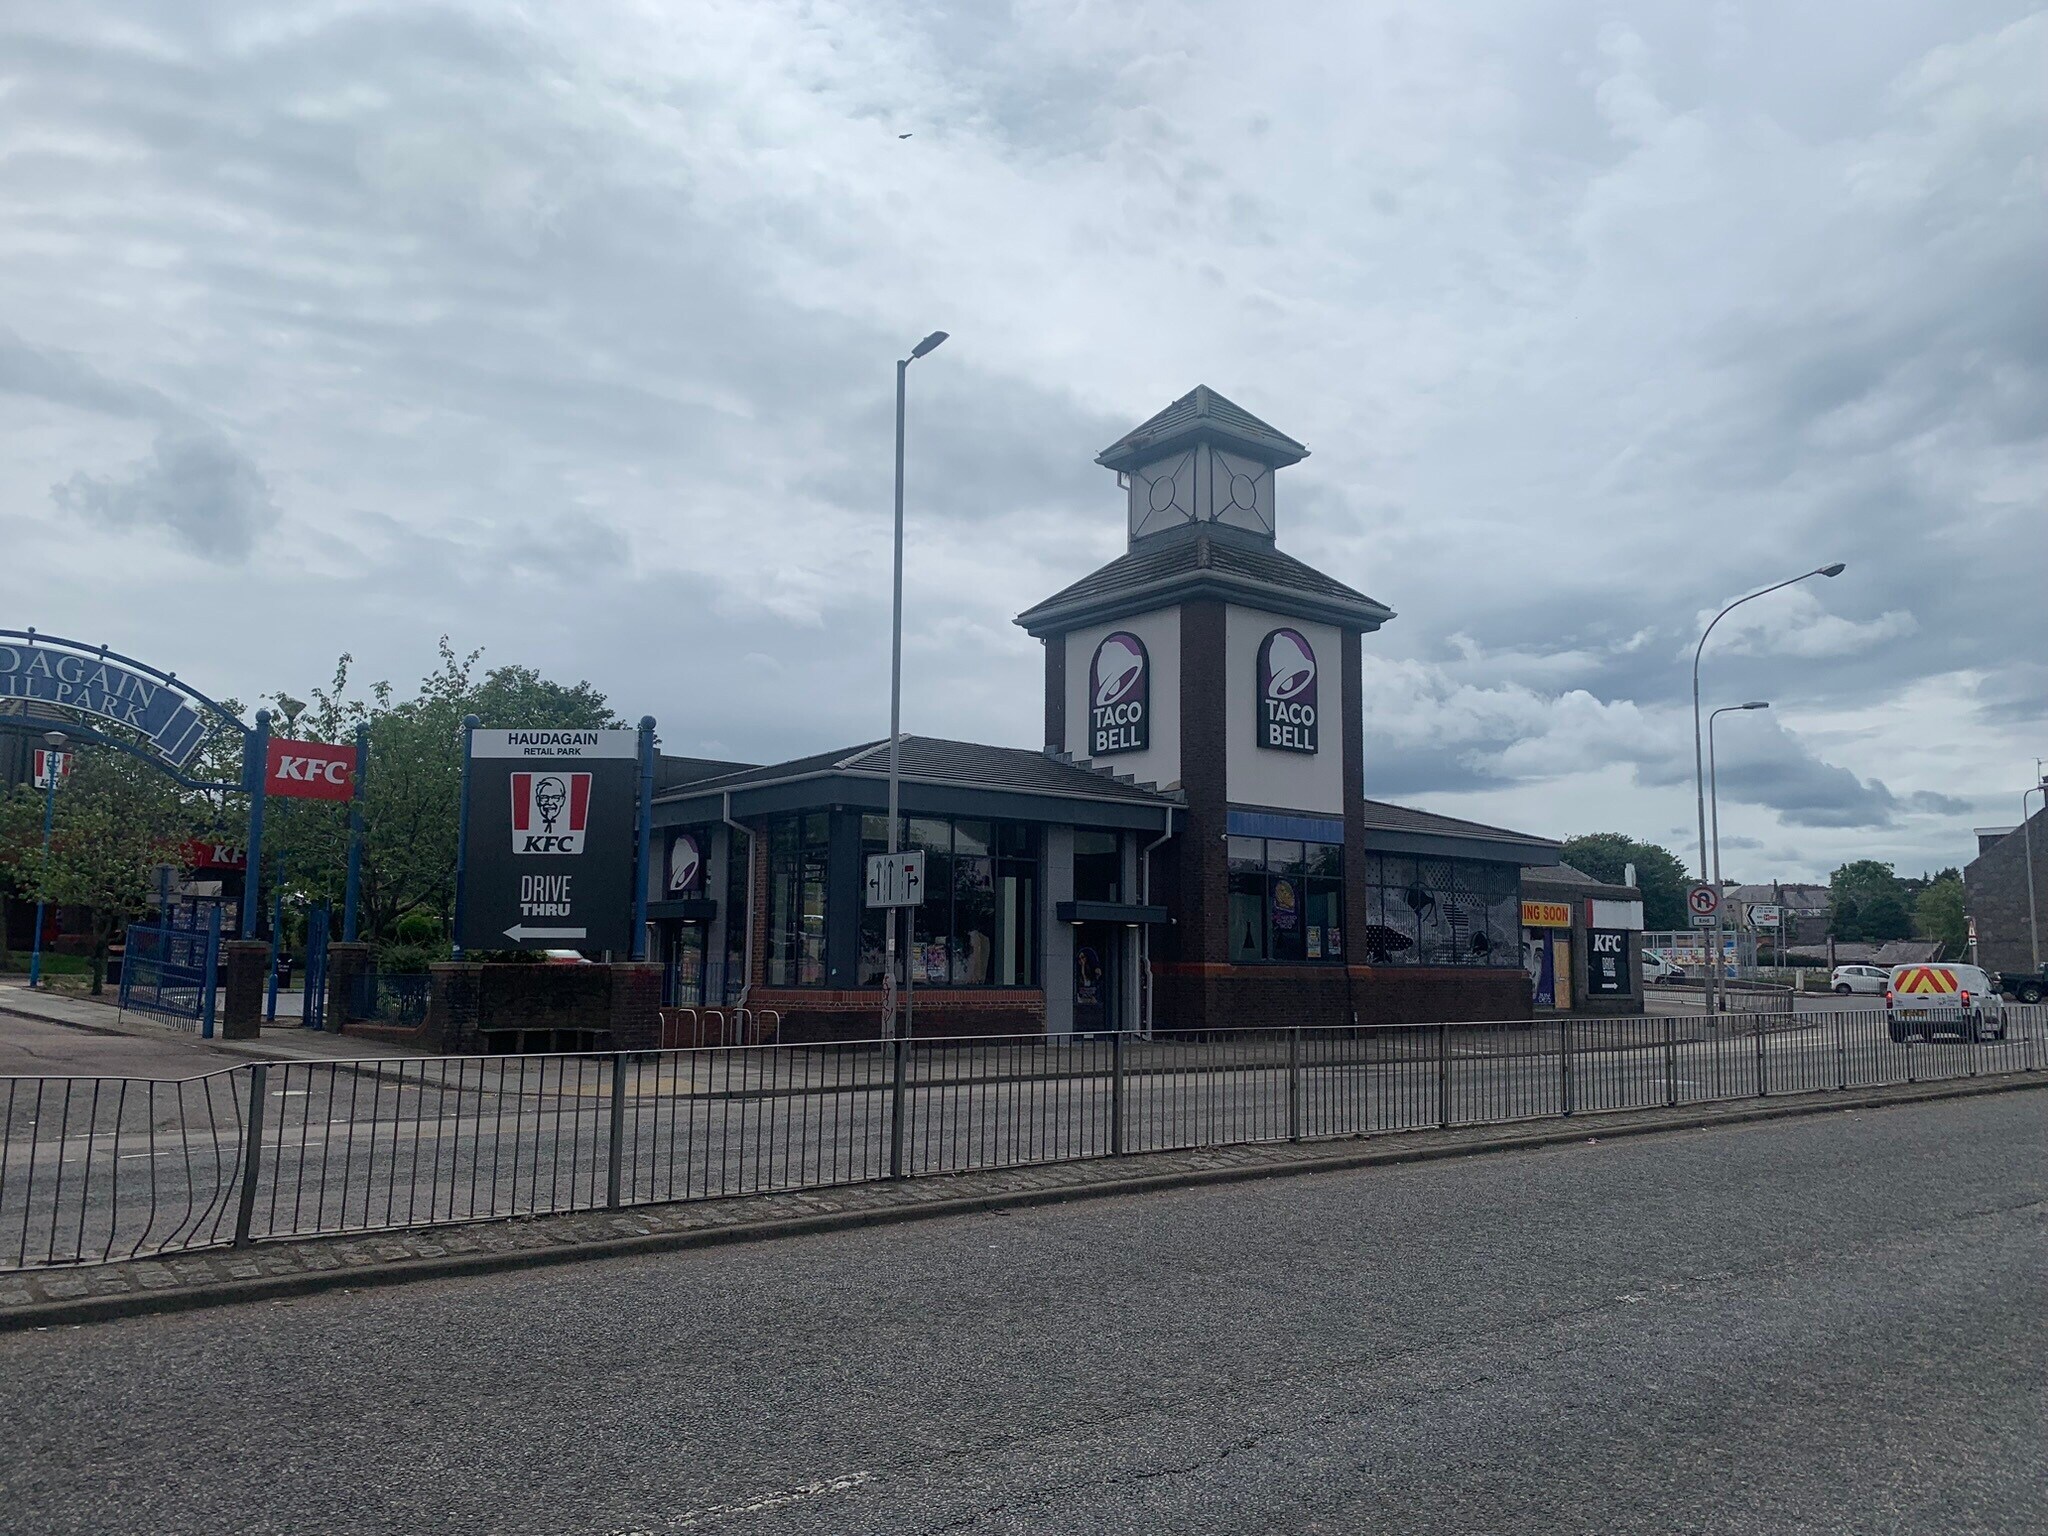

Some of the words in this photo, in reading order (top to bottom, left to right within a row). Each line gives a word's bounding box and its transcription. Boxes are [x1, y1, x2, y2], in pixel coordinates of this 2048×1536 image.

[0, 675, 42, 697] IL
[56, 682, 145, 727] PARK
[1265, 699, 1315, 726] TACO
[1093, 701, 1142, 728] TACO
[508, 733, 598, 745] HAUDAGAIN
[1096, 725, 1141, 751] BELL
[1269, 724, 1314, 750] BELL
[275, 755, 348, 785] KFC
[211, 845, 244, 863] KF
[523, 836, 574, 852] KFC
[520, 875, 572, 902] DRIVE
[520, 904, 570, 916] THRU
[1523, 904, 1541, 920] ING
[1543, 906, 1569, 922] SOON
[1593, 934, 1621, 952] KFC
